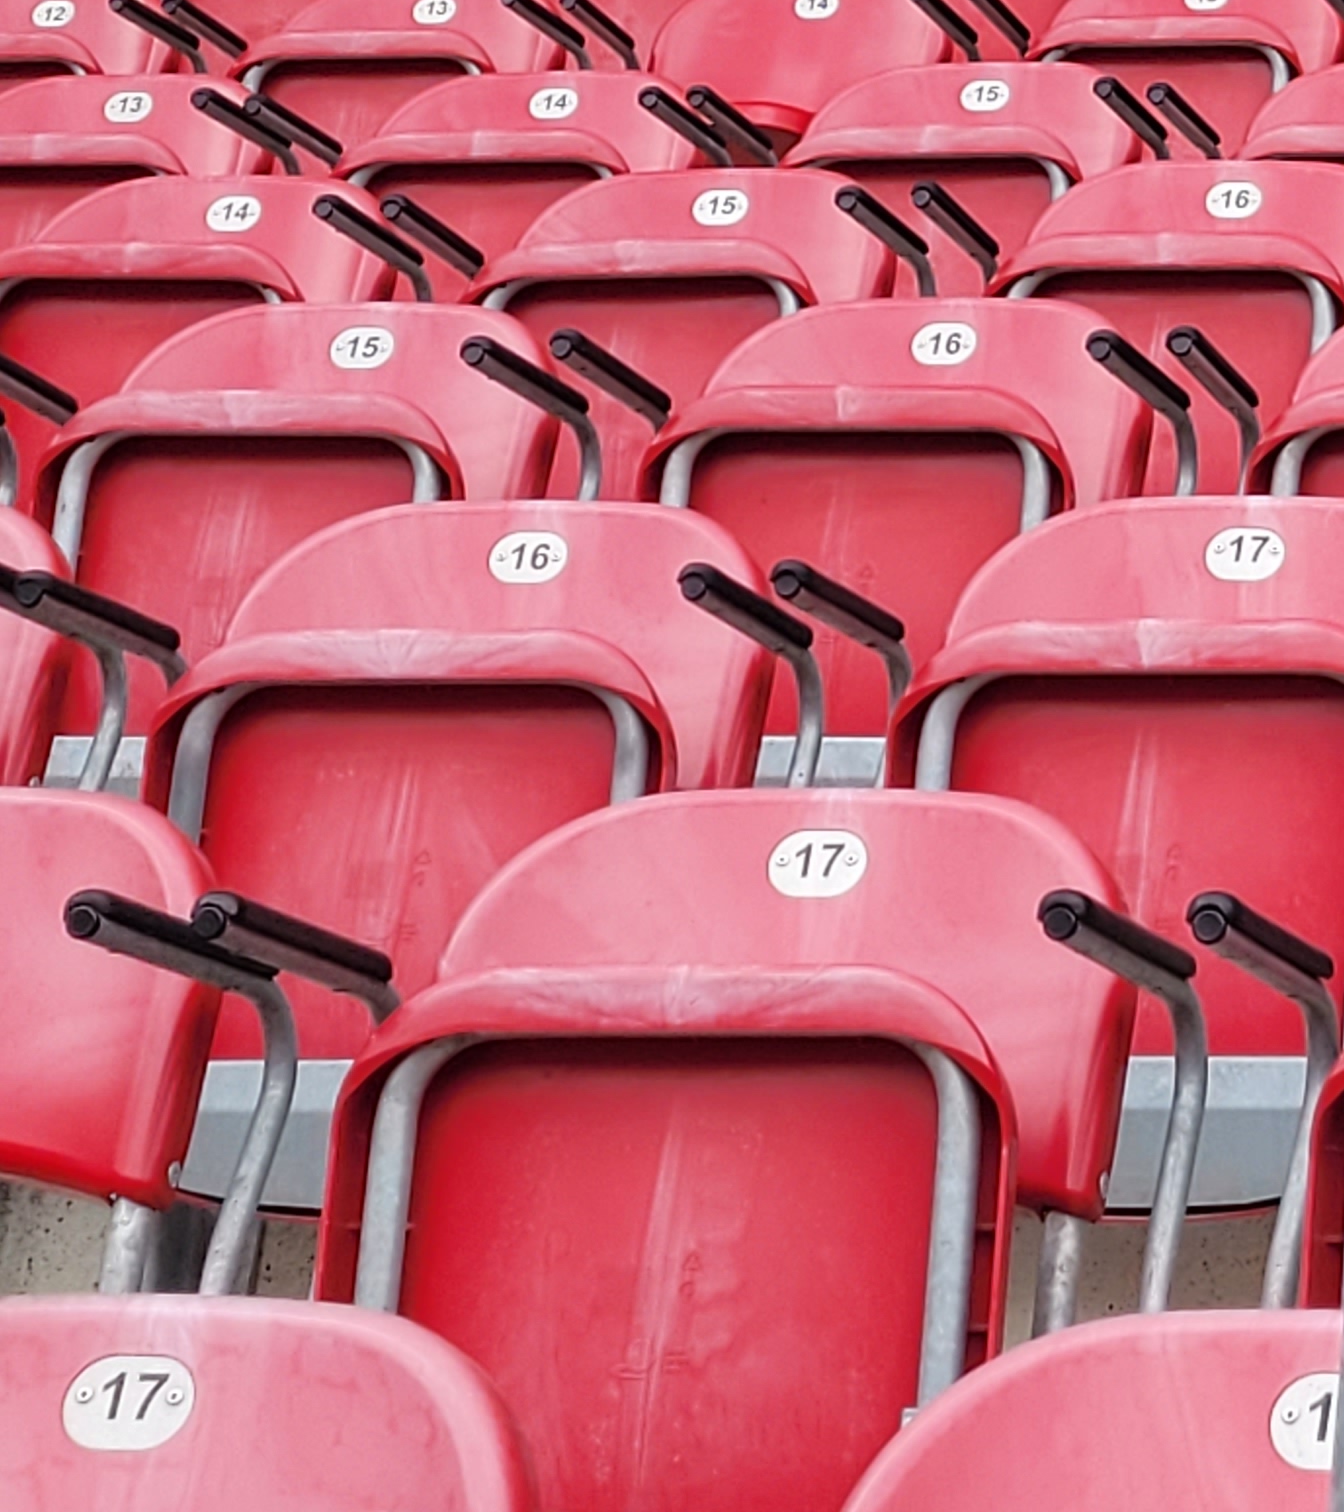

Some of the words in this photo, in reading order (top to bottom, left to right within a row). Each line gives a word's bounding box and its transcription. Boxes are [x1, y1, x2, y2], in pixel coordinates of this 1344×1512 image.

[45, 5, 67, 22] 12
[427, 0, 448, 16] 13
[119, 95, 143, 113] 13
[543, 93, 567, 111] 14
[975, 85, 1000, 103] 15
[709, 195, 737, 215] 15
[1221, 189, 1251, 209] 16
[223, 202, 250, 221] 14
[347, 335, 381, 359] 15
[929, 332, 962, 355] 16
[511, 543, 551, 571] 16
[1229, 535, 1271, 563] 17
[795, 843, 846, 878] 17
[102, 1371, 170, 1421] 17
[1310, 1393, 1332, 1441] 1
